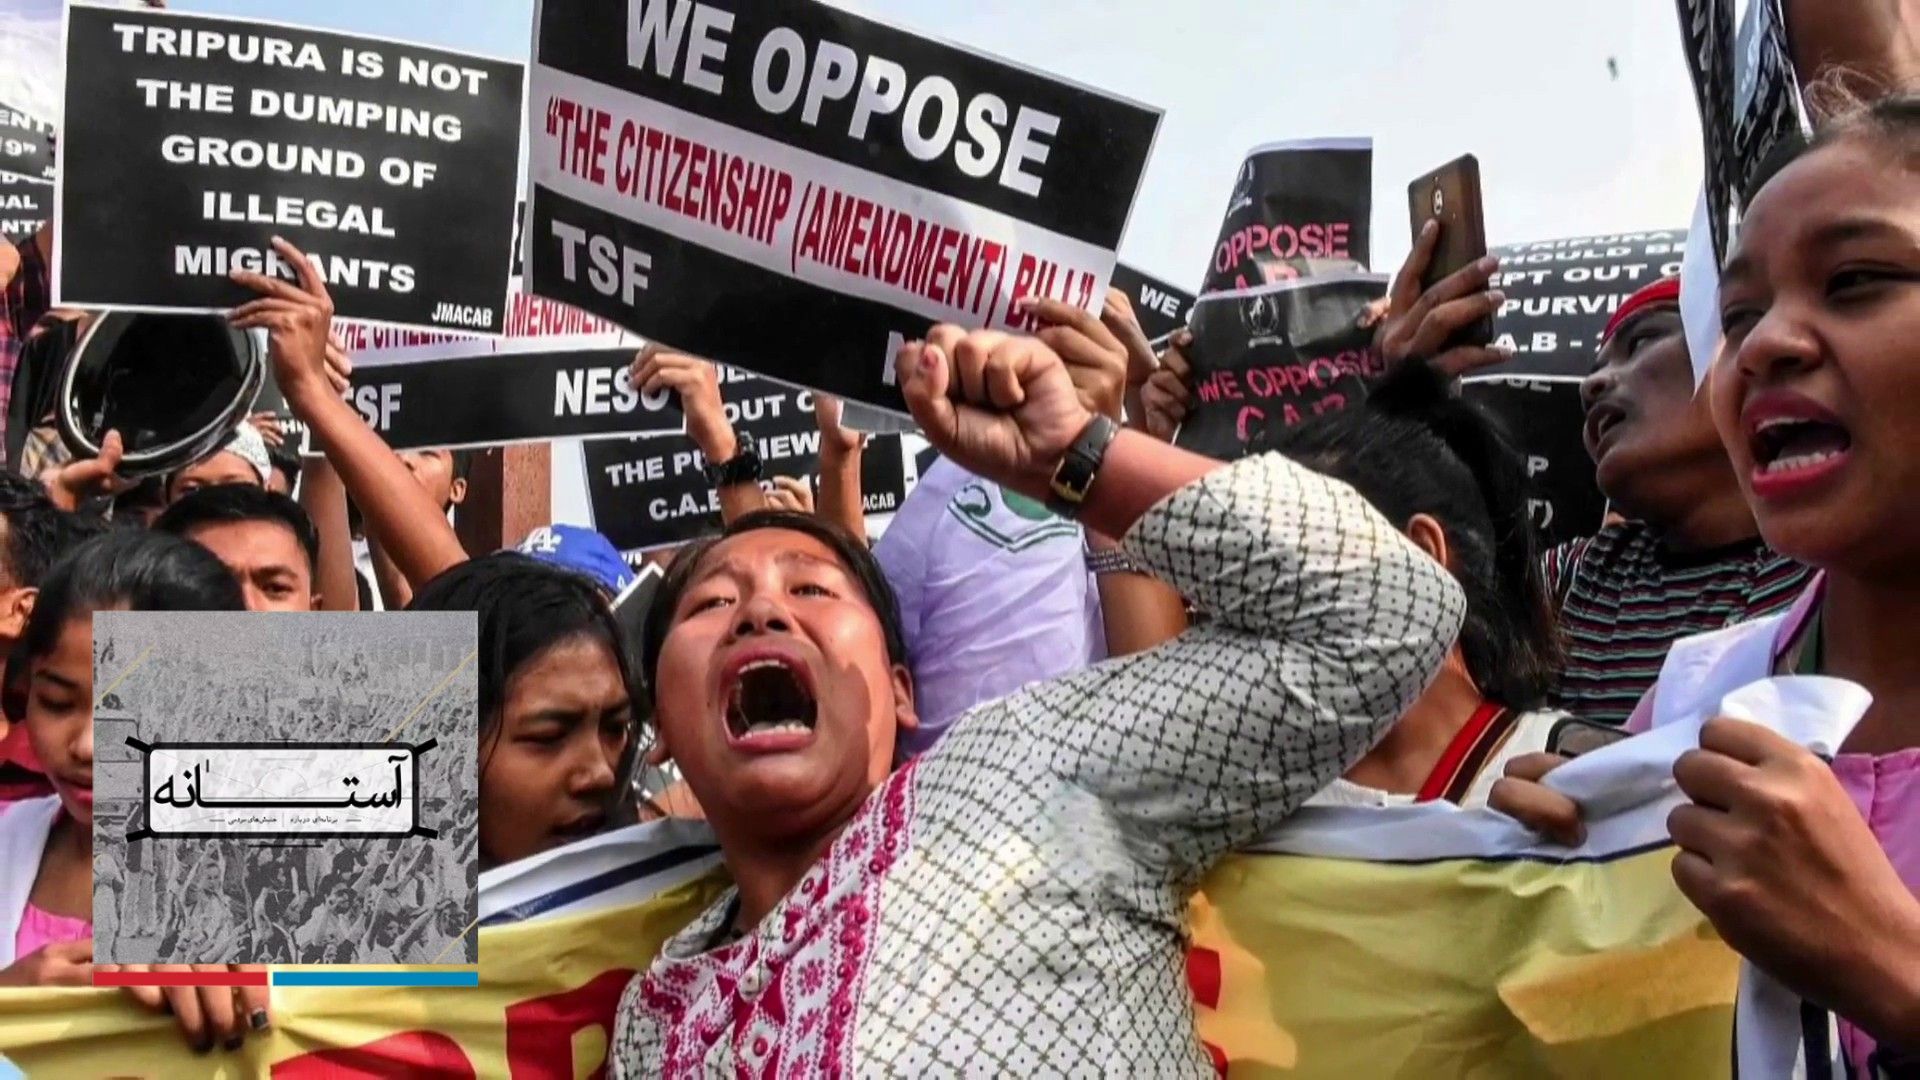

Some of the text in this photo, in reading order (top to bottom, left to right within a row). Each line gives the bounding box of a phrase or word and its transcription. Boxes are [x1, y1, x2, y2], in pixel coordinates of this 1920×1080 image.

[113, 23, 488, 95] TRIPURA IS NOT
[136, 79, 463, 142] THE DUMPING
[626, 0, 1061, 198] WE OPPOSE
[162, 135, 438, 189] GROUND OF
[203, 191, 396, 238] ILLEGAL
[615, 121, 792, 245] CITIZENSHIP
[792, 181, 1007, 329] (AMENDMENT)
[552, 220, 652, 307] TSF
[1215, 223, 1350, 273] OPPOSE
[1499, 246, 1632, 265] HOULD
[1563, 263, 1648, 282] OUT
[431, 302, 494, 327] JMACAB
[1140, 283, 1180, 318] WE
[1498, 293, 1632, 317] PURVI
[345, 383, 402, 430] SF
[1198, 370, 1244, 402] WE
[605, 457, 664, 487] THE
